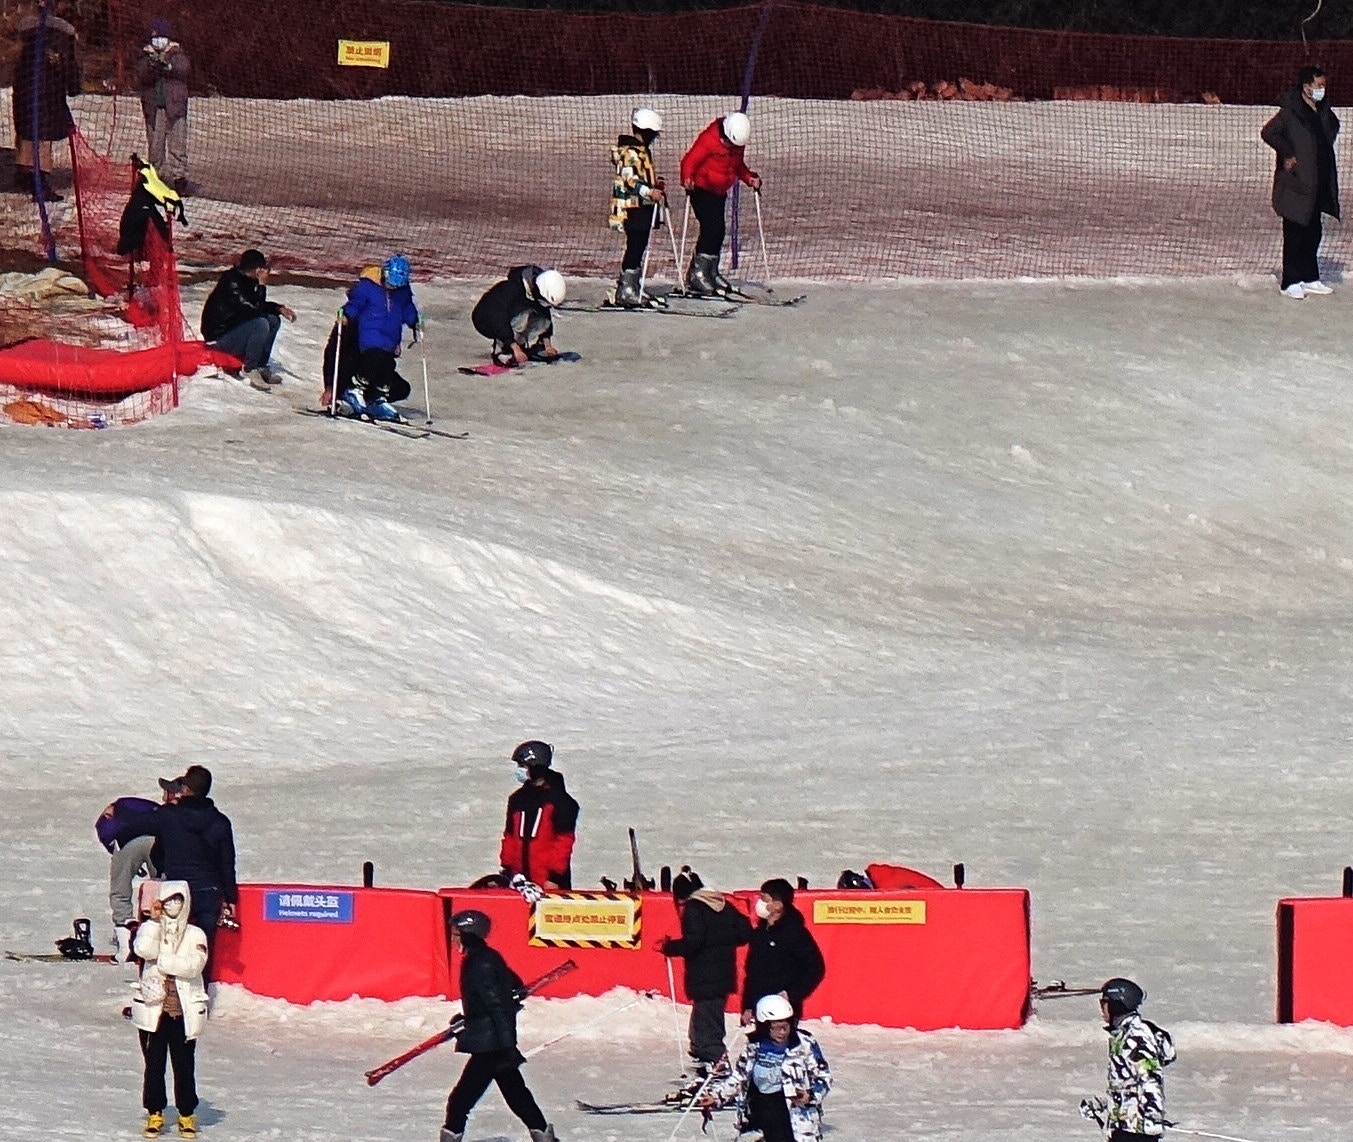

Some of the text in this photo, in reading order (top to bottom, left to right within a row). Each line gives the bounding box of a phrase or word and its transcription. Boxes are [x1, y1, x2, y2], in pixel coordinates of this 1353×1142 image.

[279, 894, 339, 908] 请佩戴头盔
[279, 909, 339, 918] Helmets required
